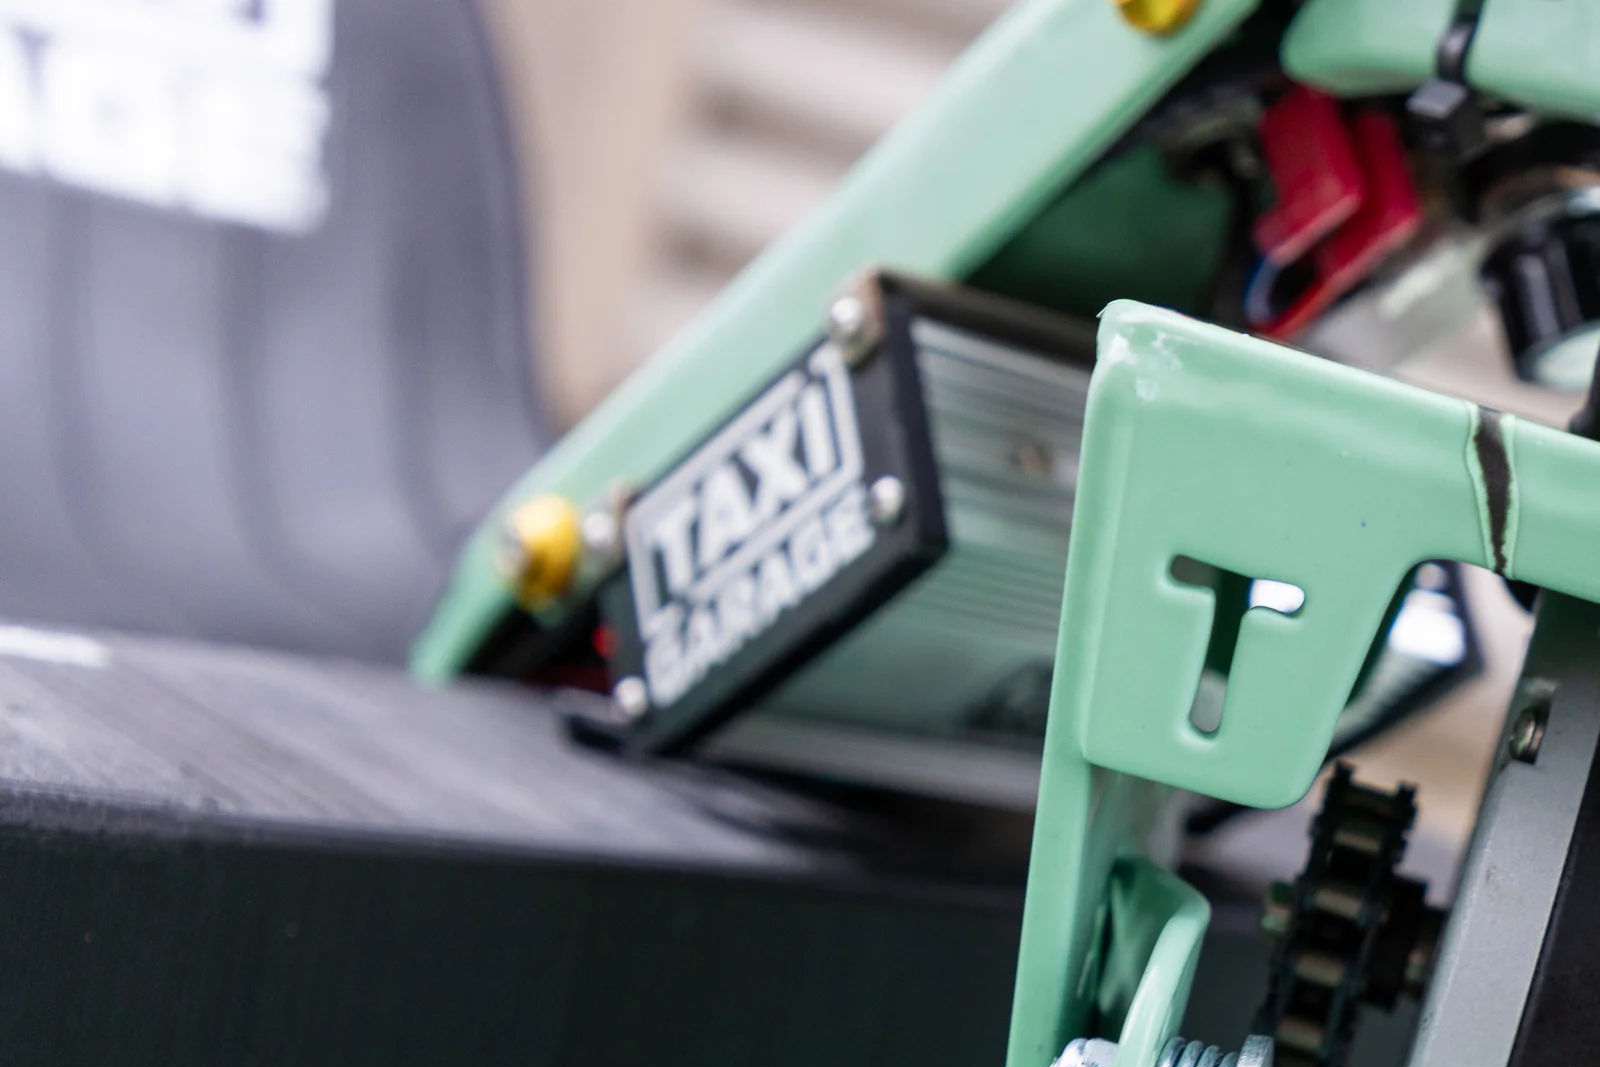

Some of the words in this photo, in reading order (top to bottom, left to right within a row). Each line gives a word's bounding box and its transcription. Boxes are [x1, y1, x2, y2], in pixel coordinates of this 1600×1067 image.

[651, 381, 836, 595] TAXI
[643, 486, 876, 708] GARAGE
[1169, 554, 1306, 734] T
